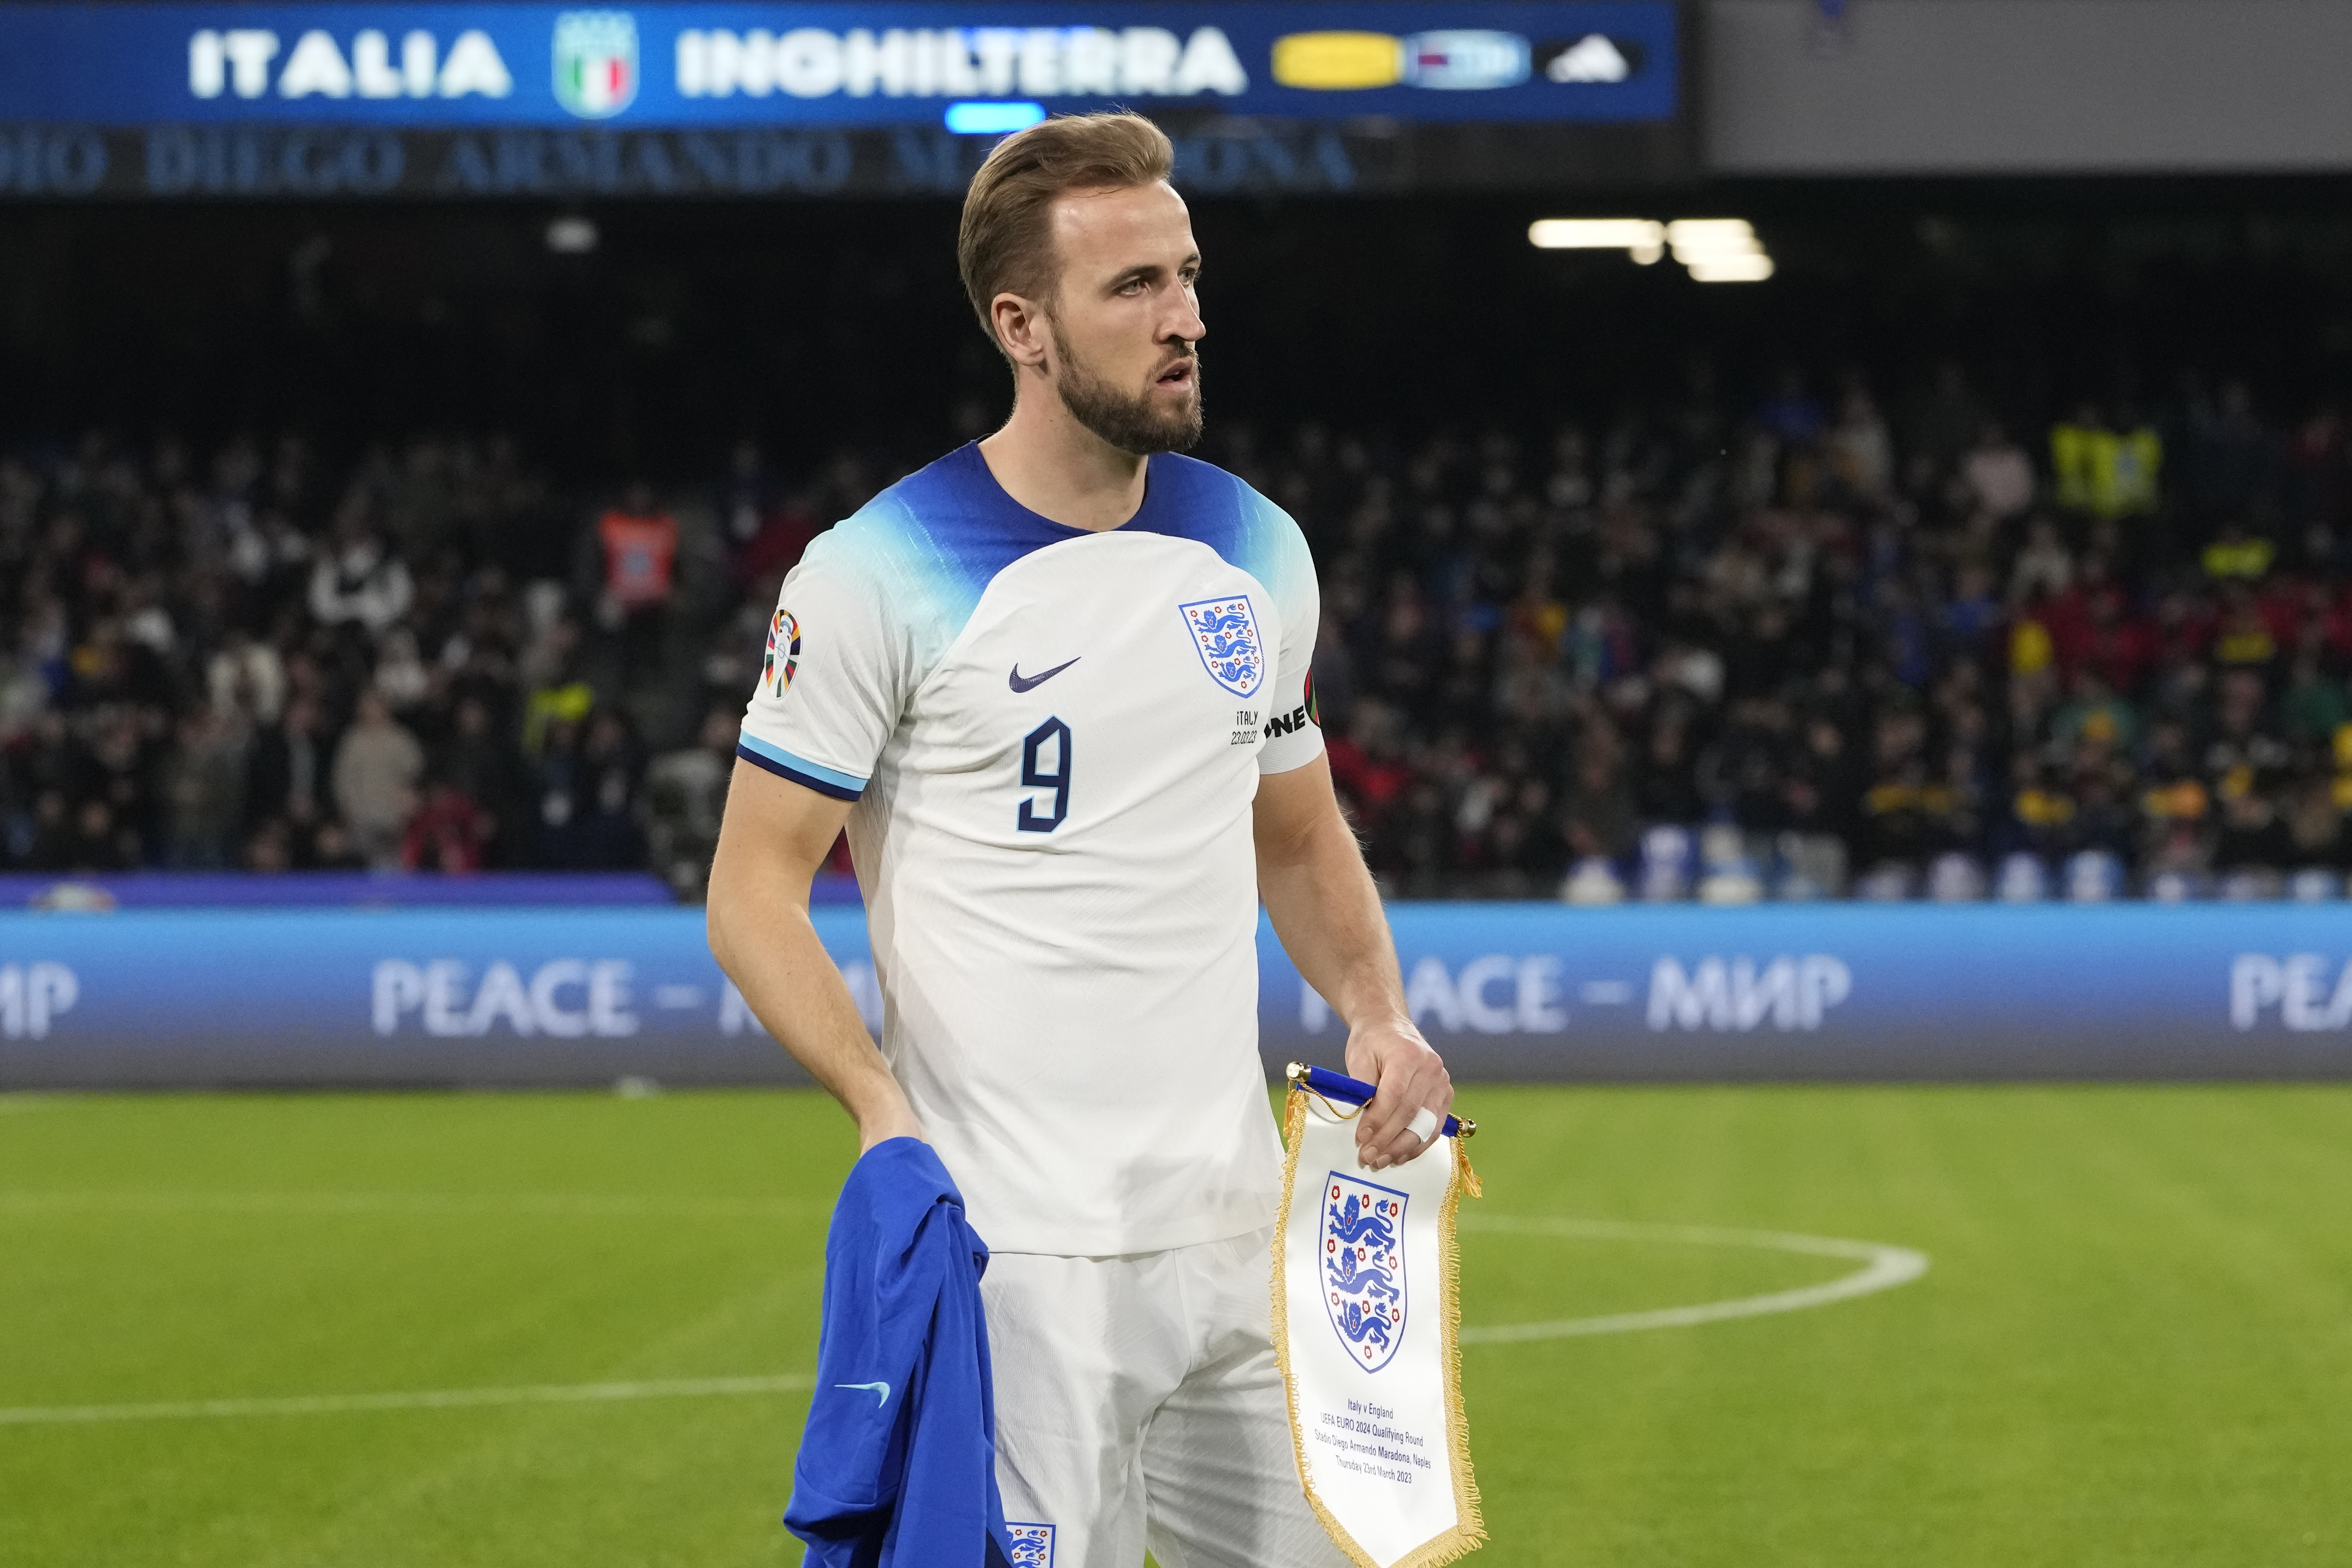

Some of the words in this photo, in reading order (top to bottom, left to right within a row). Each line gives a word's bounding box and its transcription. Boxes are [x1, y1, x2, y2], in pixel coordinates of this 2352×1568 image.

[188, 28, 515, 100] ITALIA
[674, 25, 1249, 98] INGHILTERRA
[145, 124, 407, 192] DIEGO
[1231, 730, 1257, 745] 23.03.23
[1016, 714, 1072, 834] 9
[371, 958, 640, 1039] PEACE
[1320, 1412, 1336, 1427] UEFA
[1337, 1416, 1354, 1431] EURO
[1356, 1421, 1371, 1435] 2024
[1372, 1424, 1403, 1445] Qualifying
[1406, 1431, 1424, 1447] Round
[1348, 1398, 1361, 1415] Italy
[1363, 1404, 1367, 1413] v
[1369, 1402, 1393, 1419] England
[1314, 1429, 1331, 1444] Stadio
[1332, 1434, 1348, 1451] Diego
[1350, 1439, 1376, 1456] Armando
[1379, 1446, 1412, 1466] Maradona,
[1413, 1453, 1431, 1469] Naples
[1335, 1455, 1362, 1475] Thursday
[1363, 1462, 1376, 1475] 23rd
[1377, 1465, 1395, 1481] March
[1397, 1471, 1412, 1484] 2023
